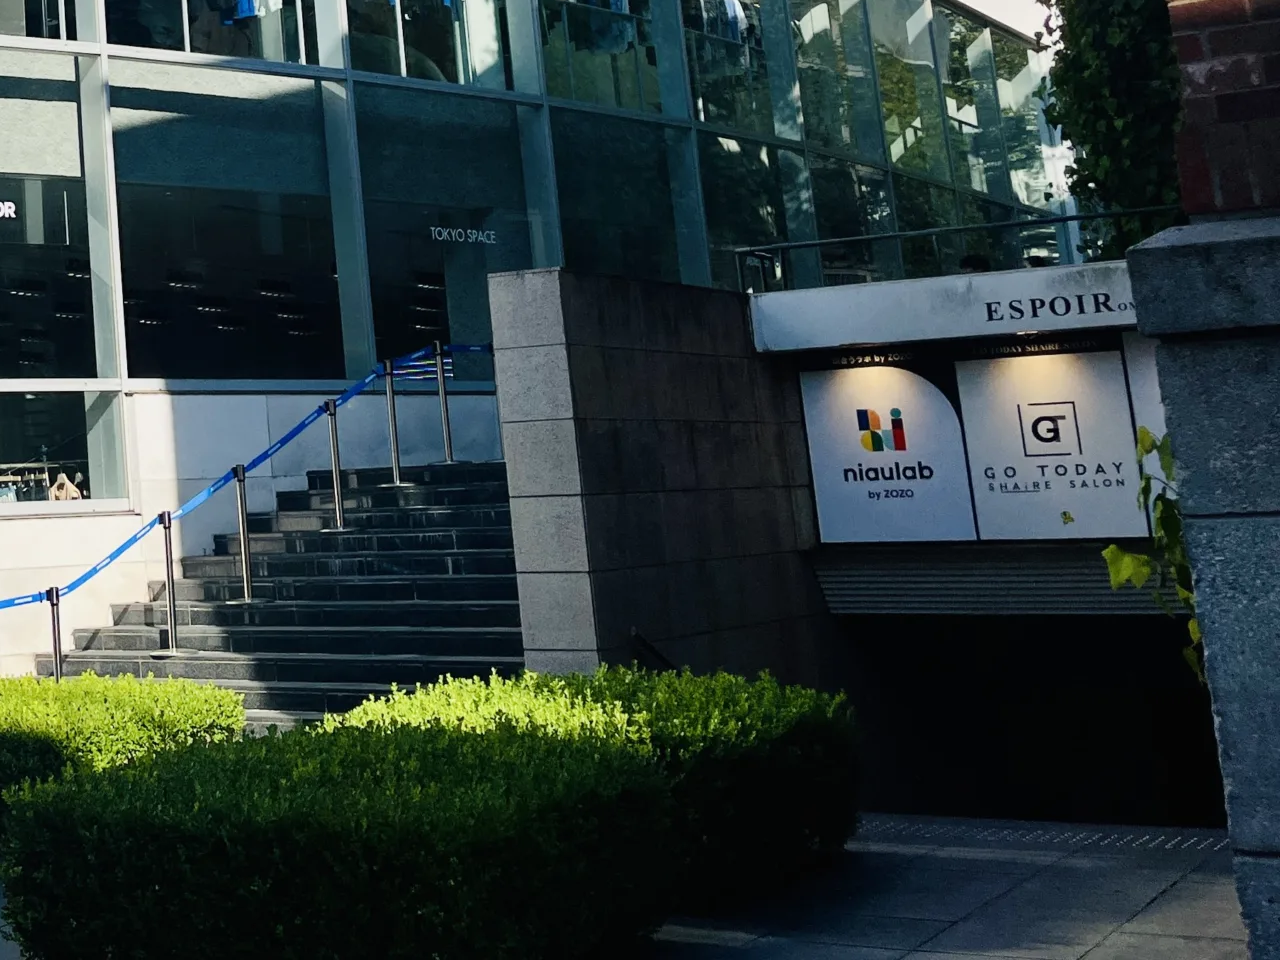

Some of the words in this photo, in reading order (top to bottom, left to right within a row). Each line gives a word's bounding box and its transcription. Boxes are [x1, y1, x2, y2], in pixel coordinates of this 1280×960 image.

[430, 227, 465, 242] TOKYO
[467, 230, 496, 243] SPACE
[985, 292, 1116, 322] ESPOIR
[843, 460, 934, 482] niaulab
[984, 466, 1017, 479] GO
[1036, 462, 1124, 477] TODAY
[1070, 478, 1125, 489] SALON
[868, 490, 882, 500] by
[883, 488, 915, 499] ZOZO
